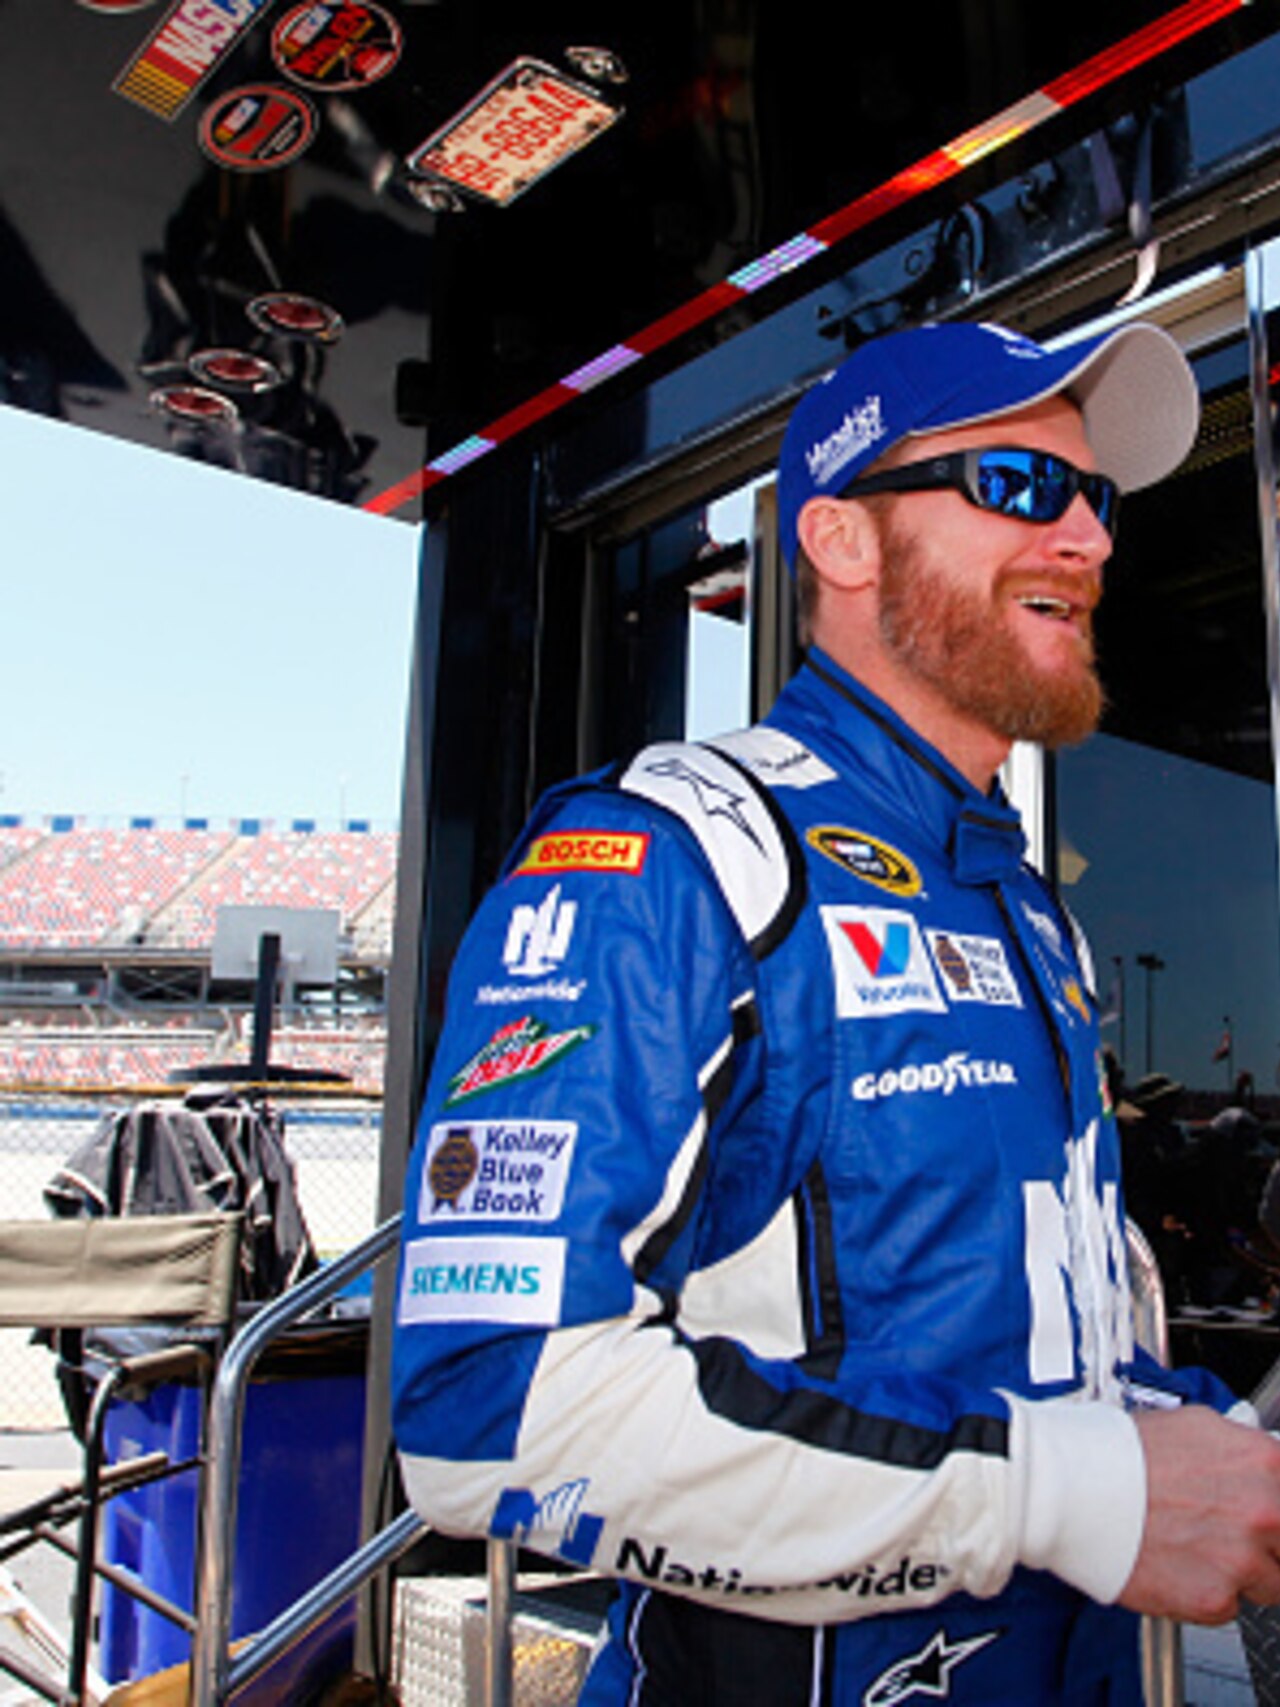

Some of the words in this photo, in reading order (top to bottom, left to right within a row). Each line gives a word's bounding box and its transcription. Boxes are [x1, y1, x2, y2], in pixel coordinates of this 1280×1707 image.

[537, 839, 632, 864] BOSCH
[484, 1126, 570, 1161] Kelley
[477, 1157, 545, 1185] Blue
[471, 1187, 545, 1215] Book
[408, 1263, 542, 1296] SIEMENS
